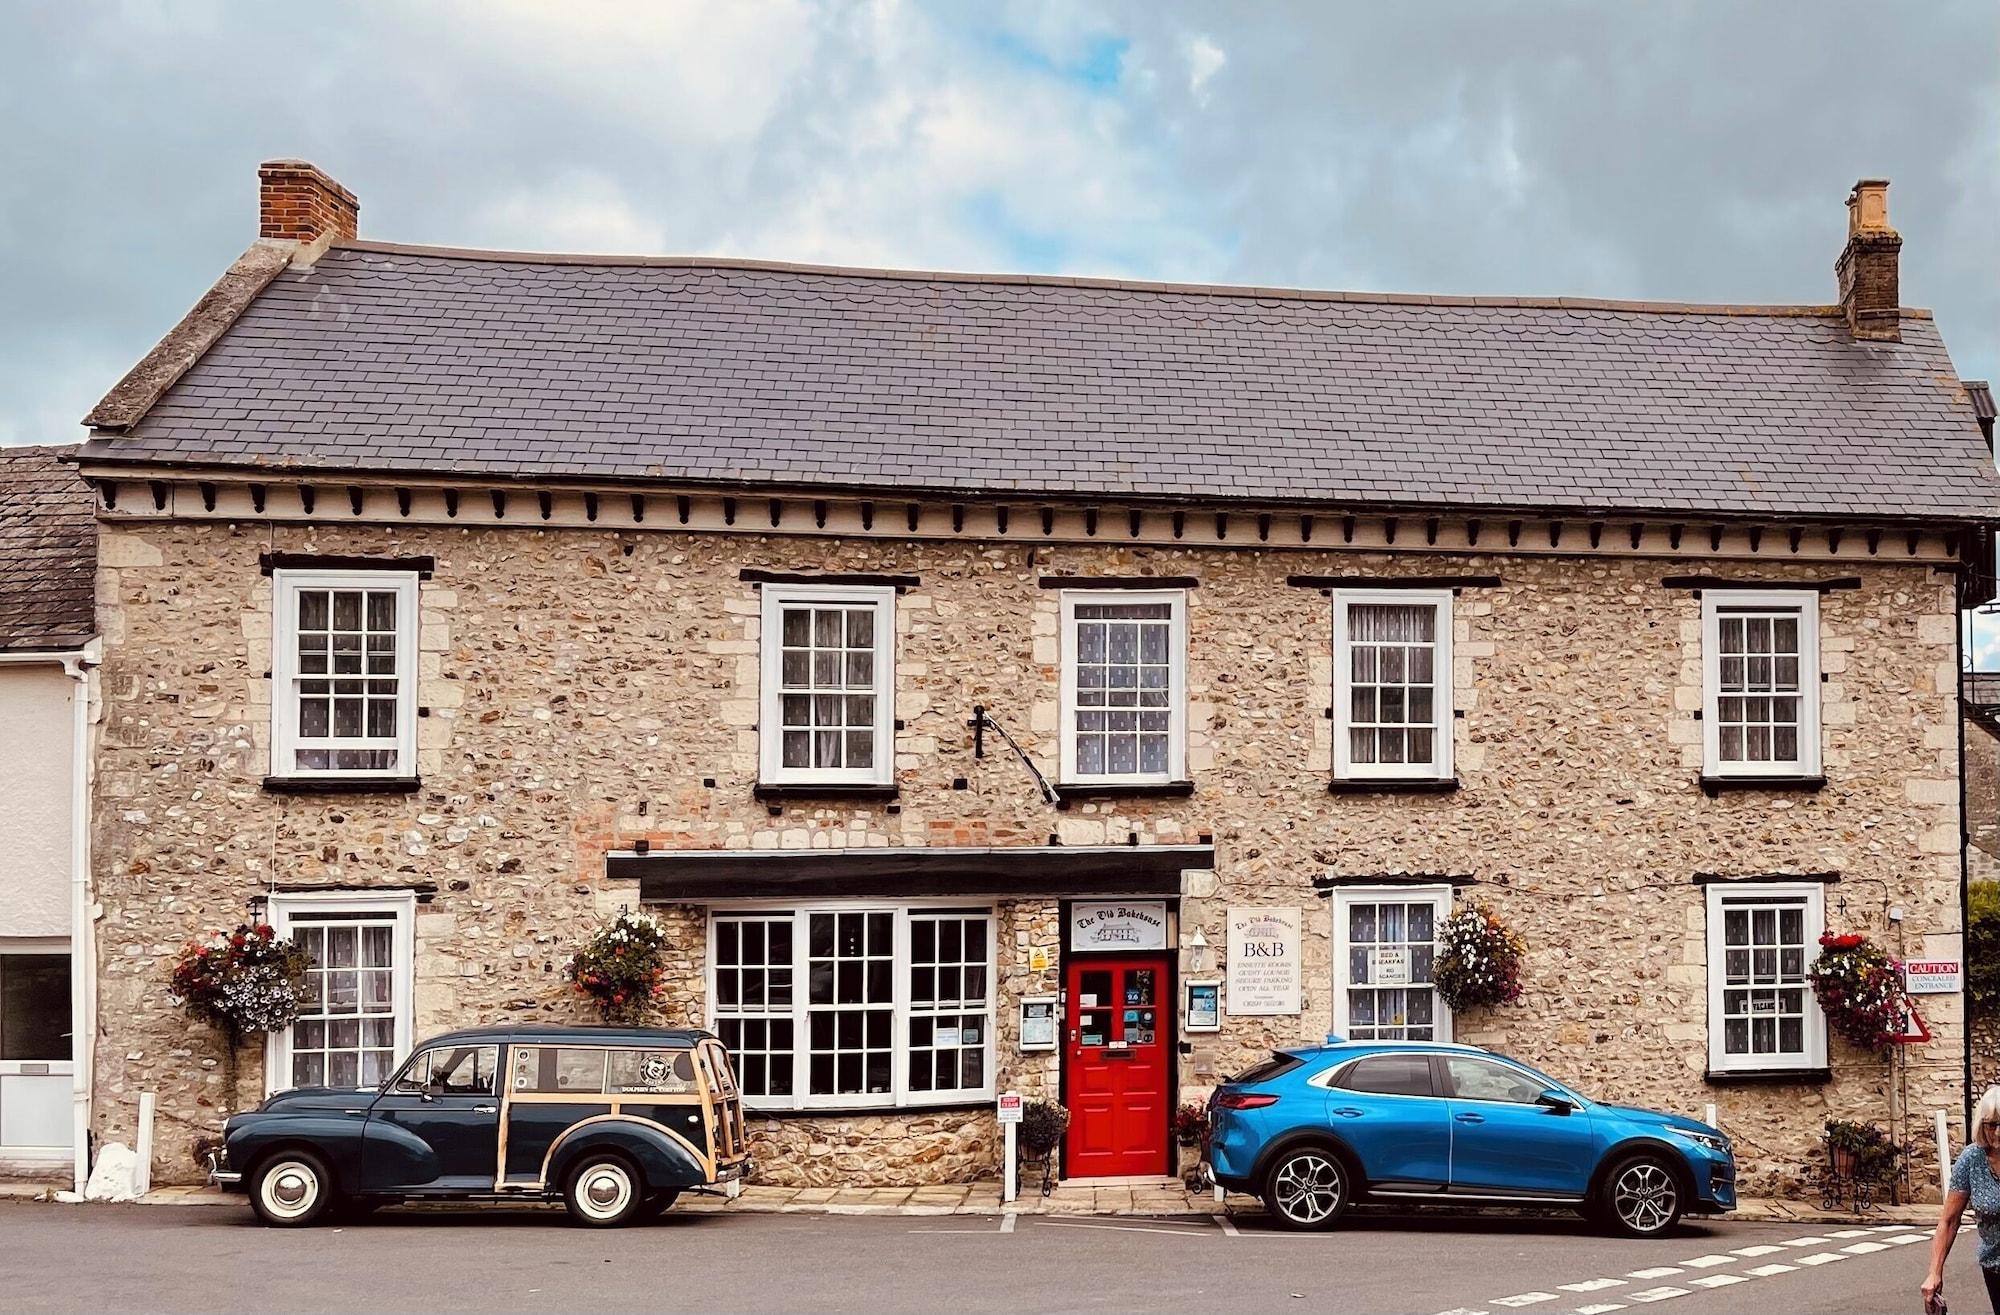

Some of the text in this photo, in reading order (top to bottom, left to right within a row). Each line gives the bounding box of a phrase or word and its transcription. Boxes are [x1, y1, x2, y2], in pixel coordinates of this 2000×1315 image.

[1077, 907, 1161, 929] The Old Bakehouse
[1235, 921, 1248, 930] The
[1244, 942, 1284, 957] B&B
[1909, 963, 1957, 973] CAUTION
